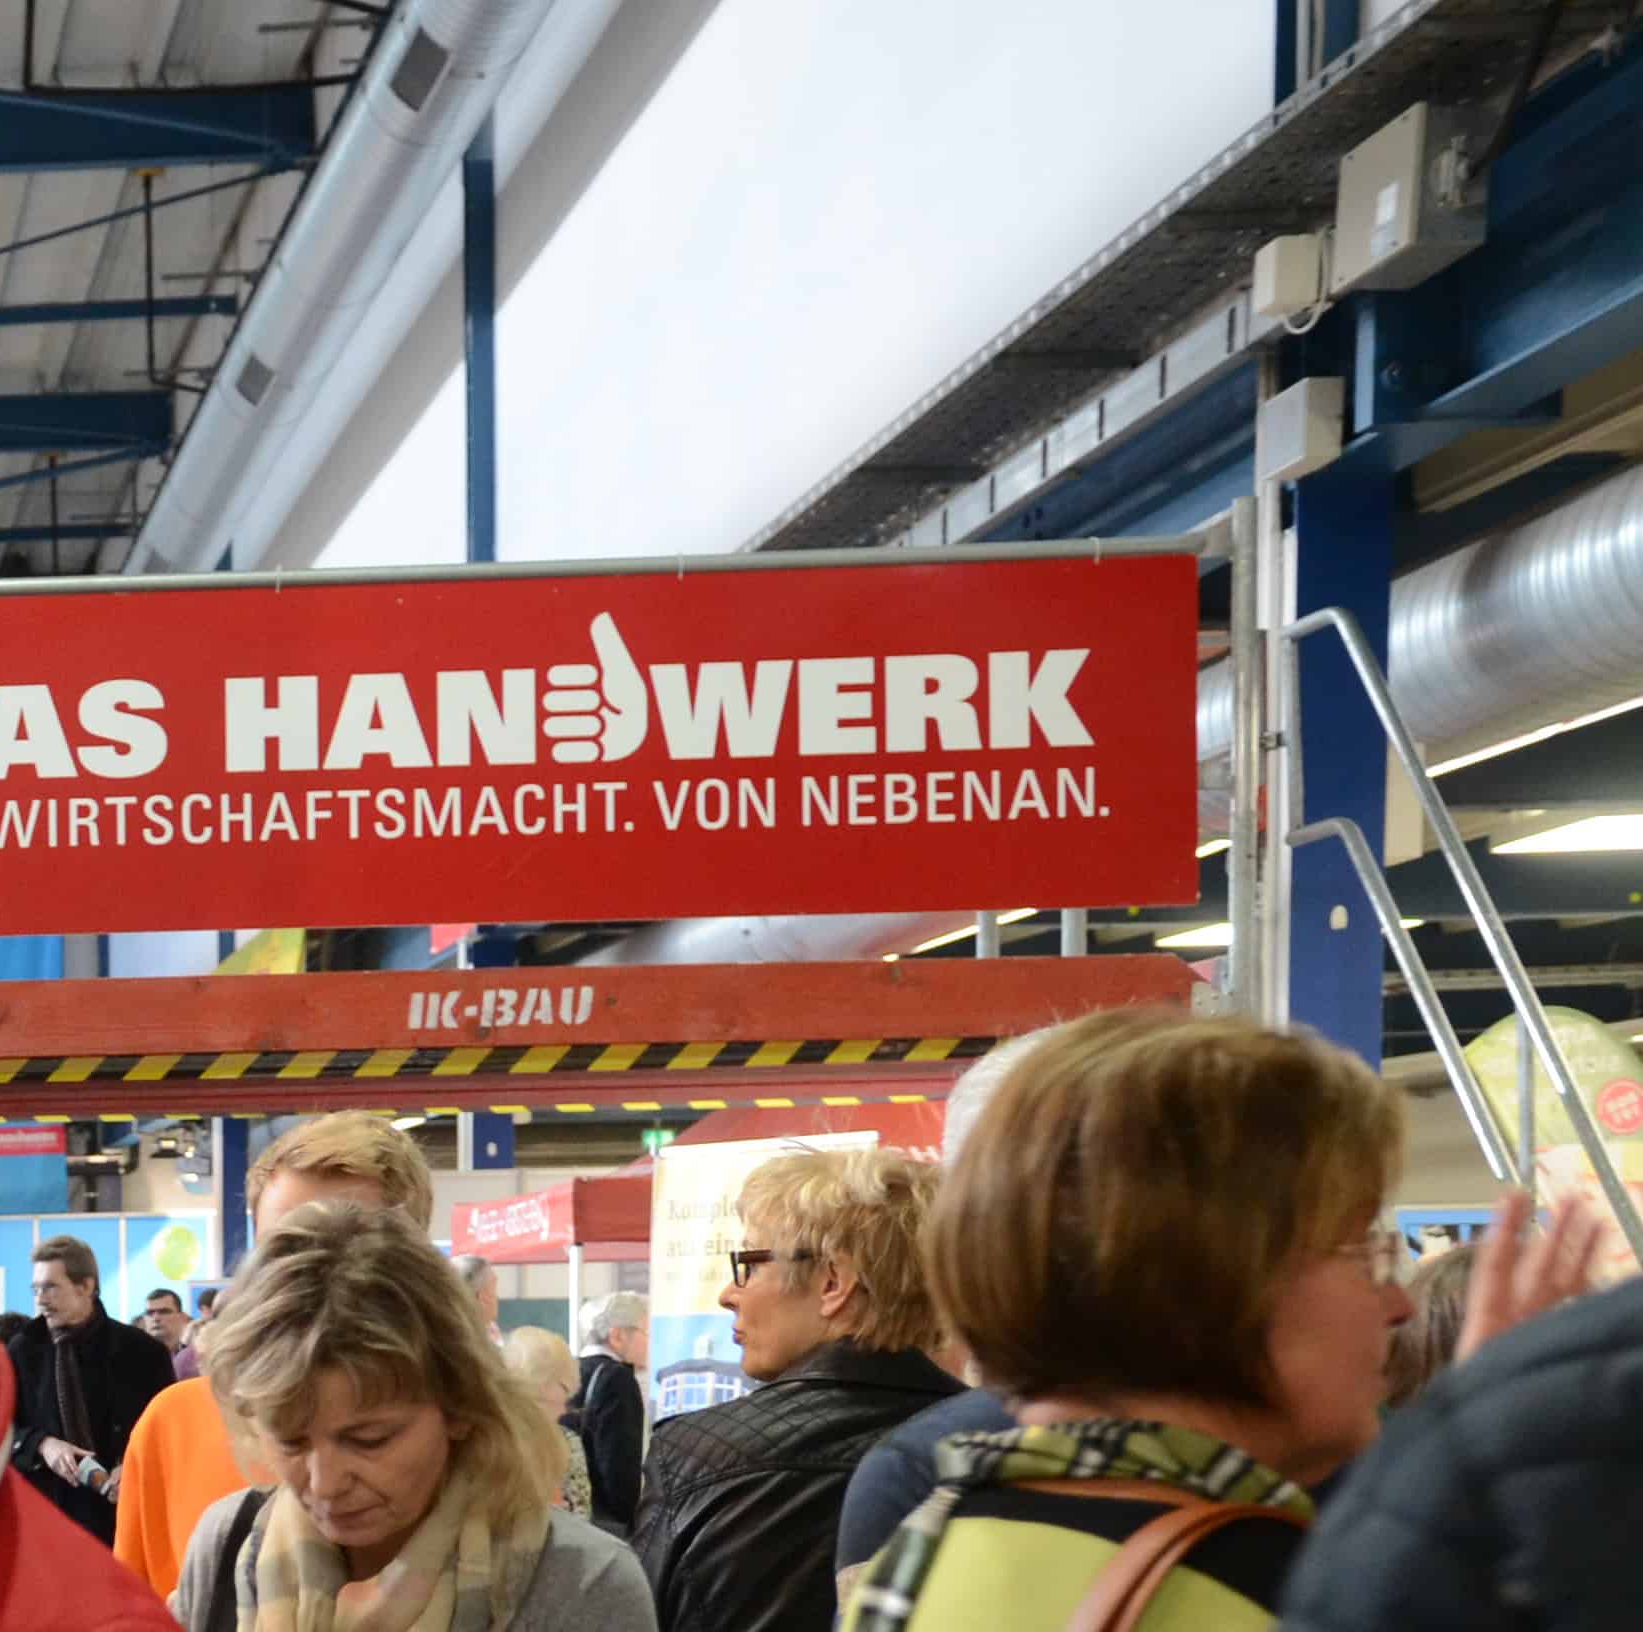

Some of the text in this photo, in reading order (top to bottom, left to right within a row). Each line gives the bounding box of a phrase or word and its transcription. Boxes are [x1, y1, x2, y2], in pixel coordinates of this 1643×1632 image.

[652, 775, 781, 832] VON
[800, 766, 1111, 828] NEBENAN.
[407, 986, 595, 1032] IK-BAU
